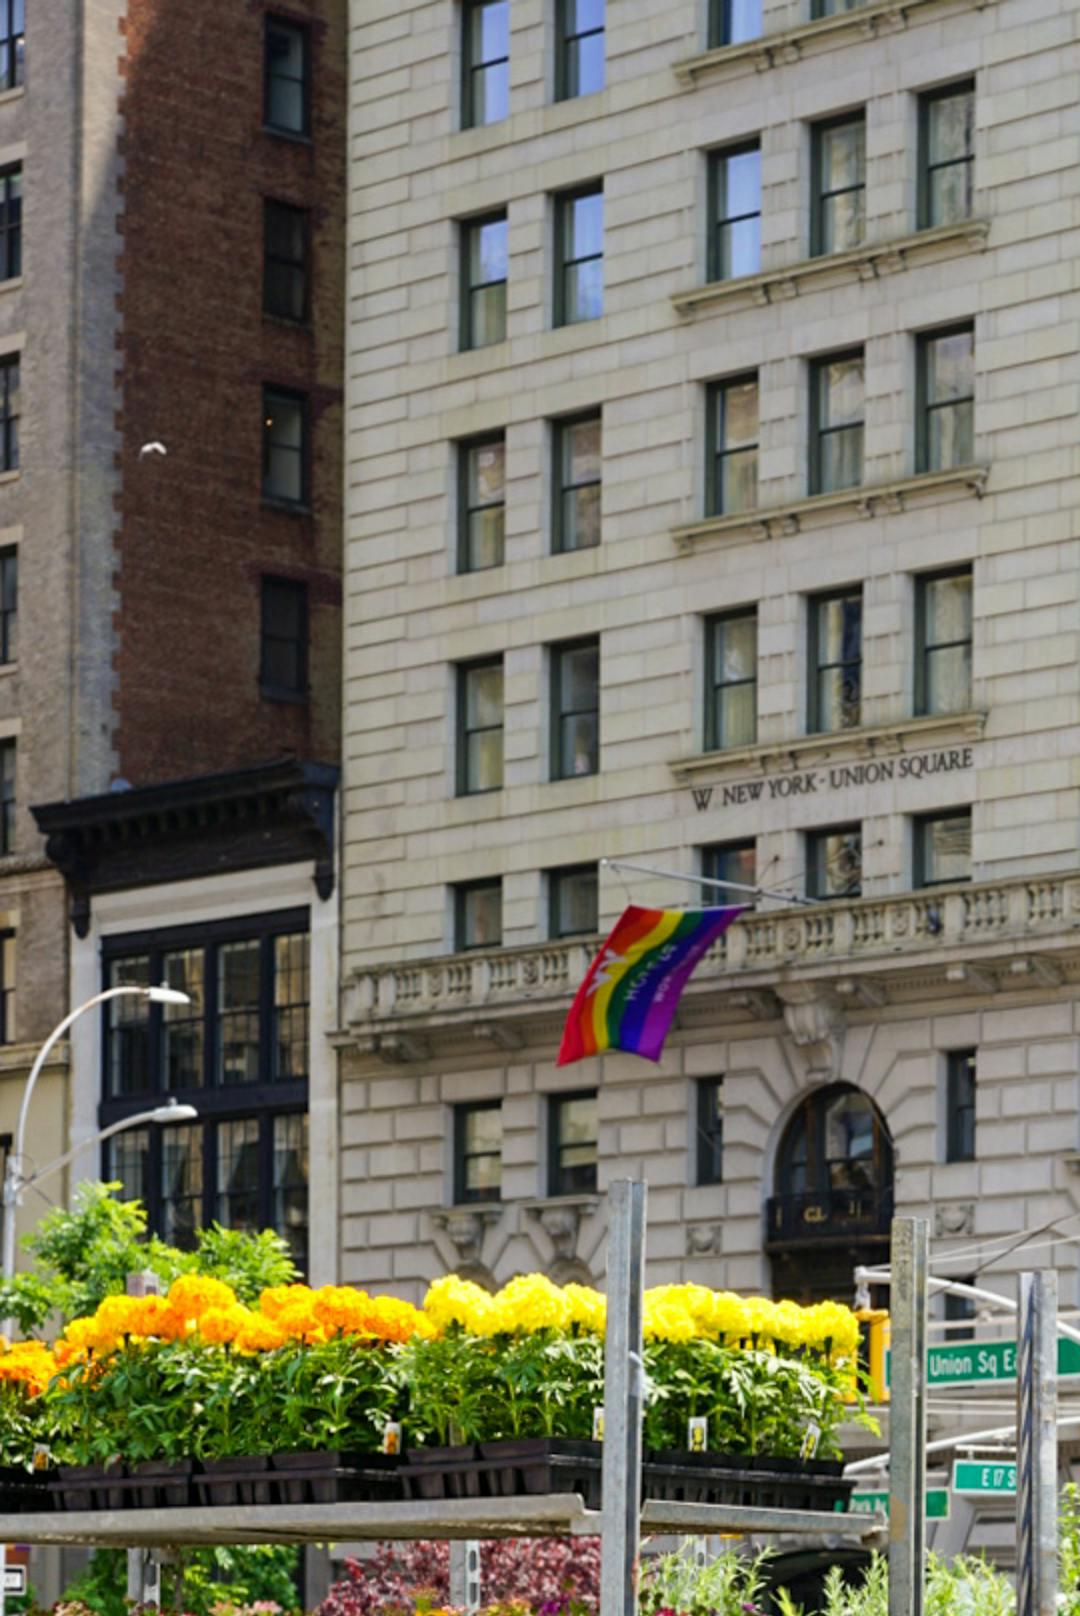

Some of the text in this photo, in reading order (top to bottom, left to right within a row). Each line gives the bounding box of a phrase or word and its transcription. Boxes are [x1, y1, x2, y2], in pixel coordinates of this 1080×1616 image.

[691, 788, 712, 812] W
[722, 781, 763, 806] NEW
[768, 773, 816, 799] YORK
[829, 760, 894, 789] UNION
[899, 748, 973, 780] SQUARE
[930, 1354, 972, 1377] Union
[977, 1351, 997, 1377] Sq
[982, 1468, 1017, 1488] E 17 S
